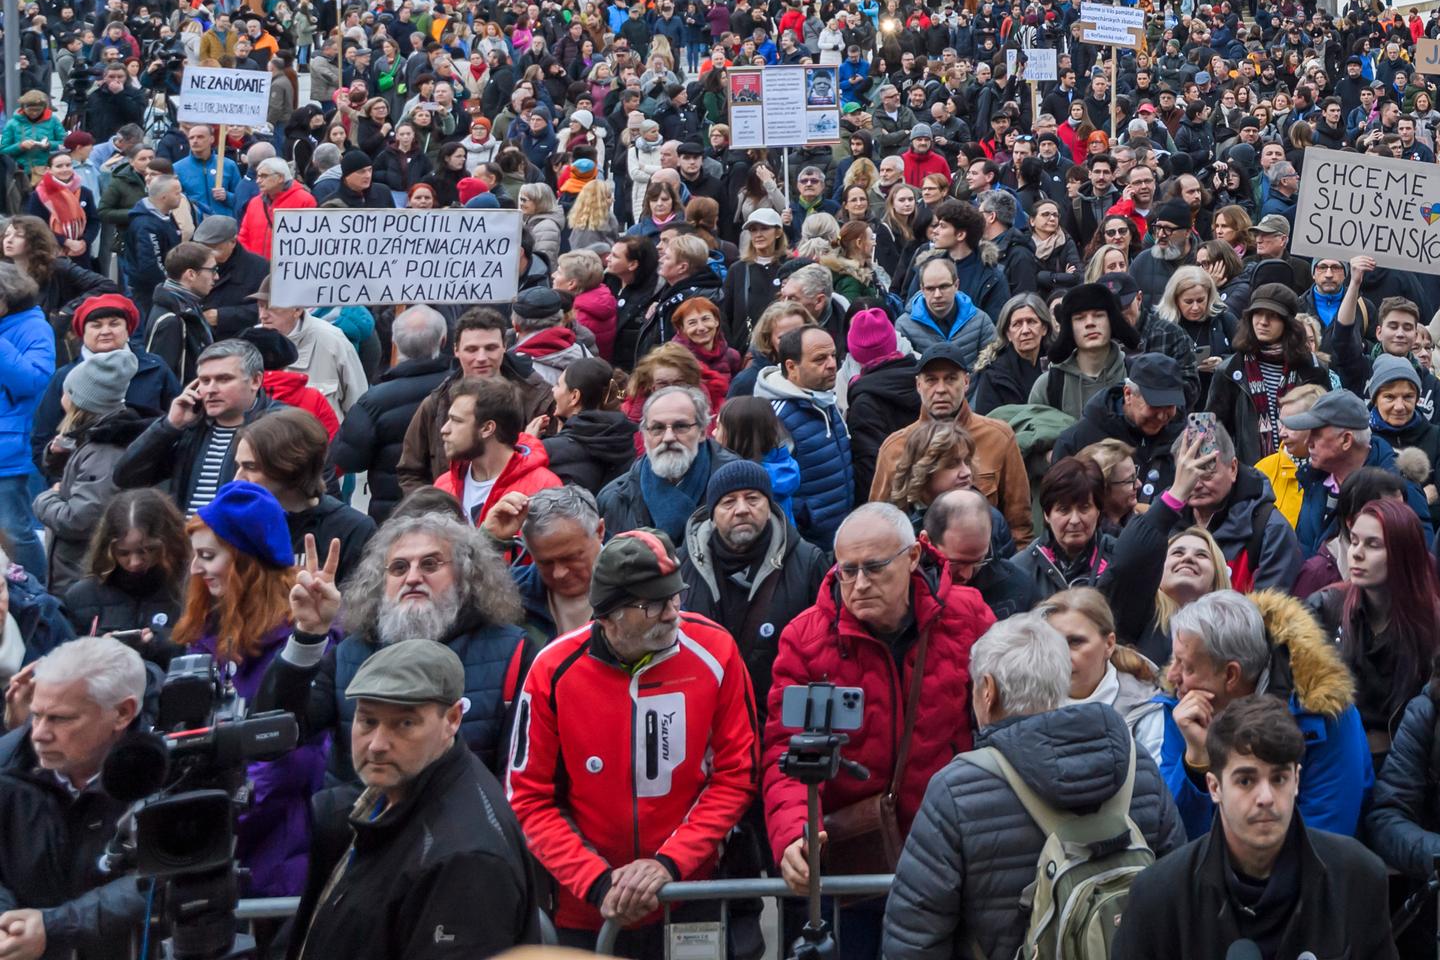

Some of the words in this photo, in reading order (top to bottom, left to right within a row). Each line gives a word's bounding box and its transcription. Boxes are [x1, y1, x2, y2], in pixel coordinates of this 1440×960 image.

[191, 73, 265, 93] NEZABÚDAME
[1316, 162, 1427, 197] CHCEME
[1313, 187, 1417, 222] SLUŠNÉ
[276, 215, 302, 233] AJ
[306, 215, 331, 233] JA
[340, 214, 378, 233] SOM
[383, 212, 452, 233] POCÍTIL
[459, 215, 487, 233] NA
[405, 257, 476, 279] POLÍCIA
[480, 260, 503, 279] ZA
[316, 284, 371, 304] FICA
[380, 284, 394, 302] A
[401, 279, 493, 301] KALIŇÁKA
[660, 718, 671, 761] SILVINI
